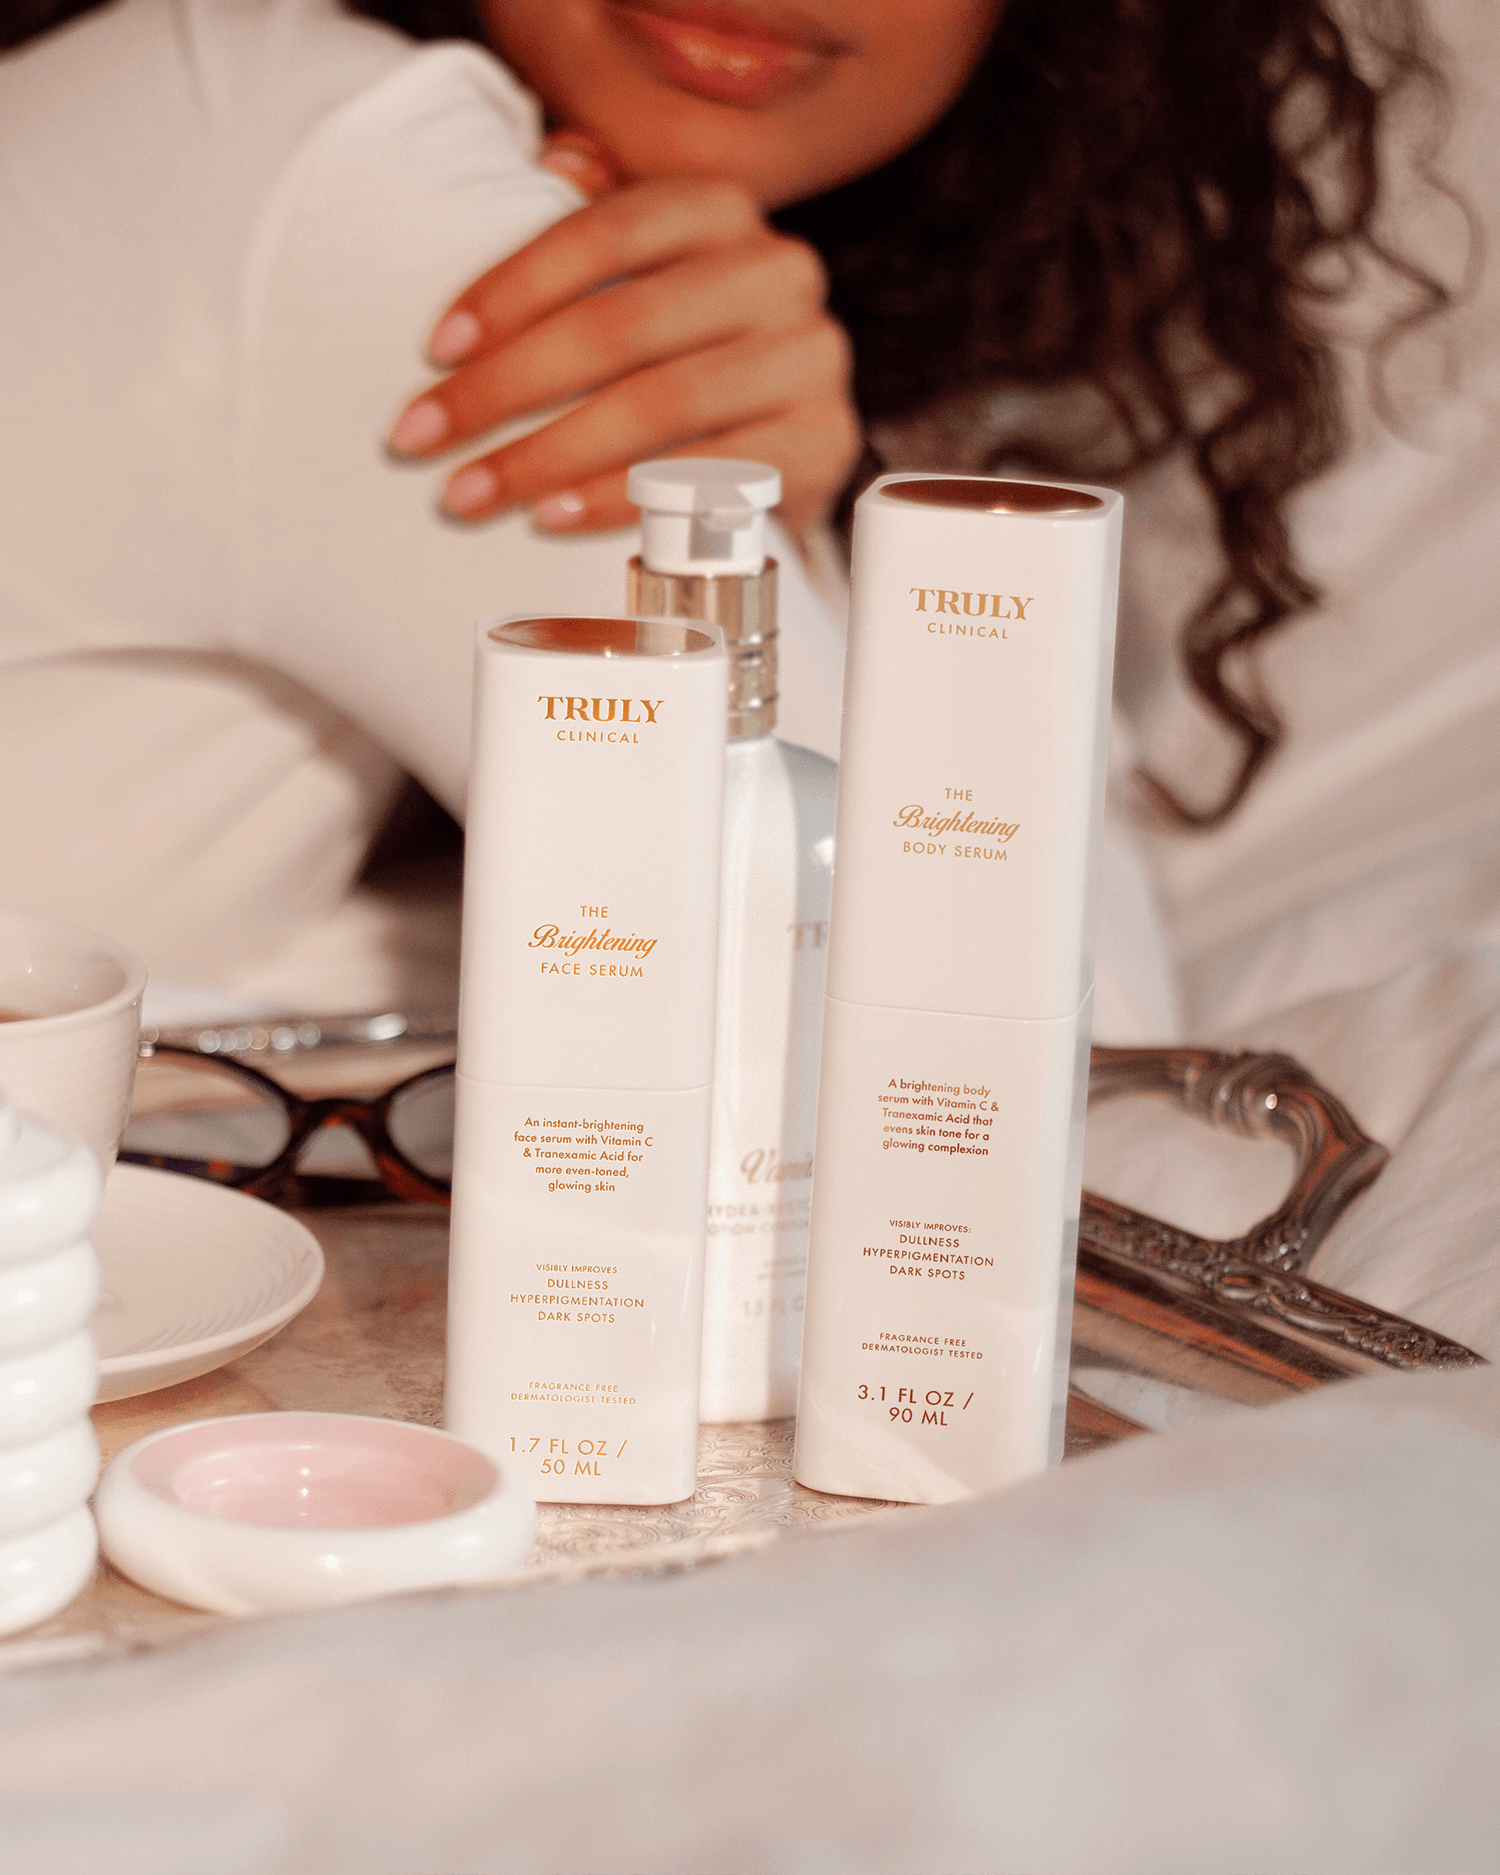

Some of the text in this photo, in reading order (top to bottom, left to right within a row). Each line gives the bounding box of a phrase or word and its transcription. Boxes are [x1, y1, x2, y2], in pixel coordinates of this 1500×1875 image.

[909, 588, 1034, 620] TRULY
[928, 623, 1007, 639] CLINICAL
[537, 696, 664, 723] TRULY
[557, 731, 638, 743] CLINICAL
[945, 788, 972, 801] THE
[893, 805, 1020, 843] Brightening
[904, 841, 1007, 861] BODY SERUM
[580, 906, 607, 918] THE
[528, 925, 657, 959] Brightening
[542, 963, 642, 977] FACE SERUM
[888, 1079, 991, 1098] A brightening body
[878, 1095, 999, 1111] serum with Vitamin C &
[883, 1108, 993, 1126] Tranexamic Acid that
[524, 1117, 643, 1134] An instant-brightening
[884, 1126, 913, 1134] evens
[916, 1125, 935, 1136] skin
[939, 1129, 961, 1138] tone
[965, 1129, 980, 1139] for
[514, 1131, 537, 1142] face
[575, 1135, 597, 1144] with
[601, 1135, 641, 1146] Vitamin
[645, 1137, 653, 1147] C
[883, 1138, 988, 1155] glowing complexion
[523, 1148, 643, 1161] & Tranexamic Acid for
[566, 1167, 628, 1178] even-toned,
[548, 1179, 614, 1193] glowing skin
[890, 1220, 971, 1233] VISIBLY IMPROVES:
[900, 1235, 959, 1248] DULLNESS
[863, 1247, 993, 1266] HYPERPIGMENTATION
[536, 1264, 620, 1274] VISIBLY IMPROVES:
[890, 1265, 964, 1280] DARK SPOTS
[548, 1279, 608, 1290] DULLNESS
[511, 1294, 643, 1308] HYPERPIGMENTATION
[538, 1311, 614, 1323] DARK SPOTS
[880, 1333, 965, 1347] FRAGRANCE FREE
[862, 1343, 983, 1359] DERMATOLOGIST TESTED
[529, 1382, 589, 1391] FRAGRANCE
[511, 1393, 594, 1403] DERMATOLOGIST
[858, 1385, 973, 1409] 3.1 FL OZ /
[889, 1407, 947, 1426] 90 ML
[510, 1437, 627, 1458] 1.7 FL OZ /
[541, 1459, 601, 1476] 50 ML
